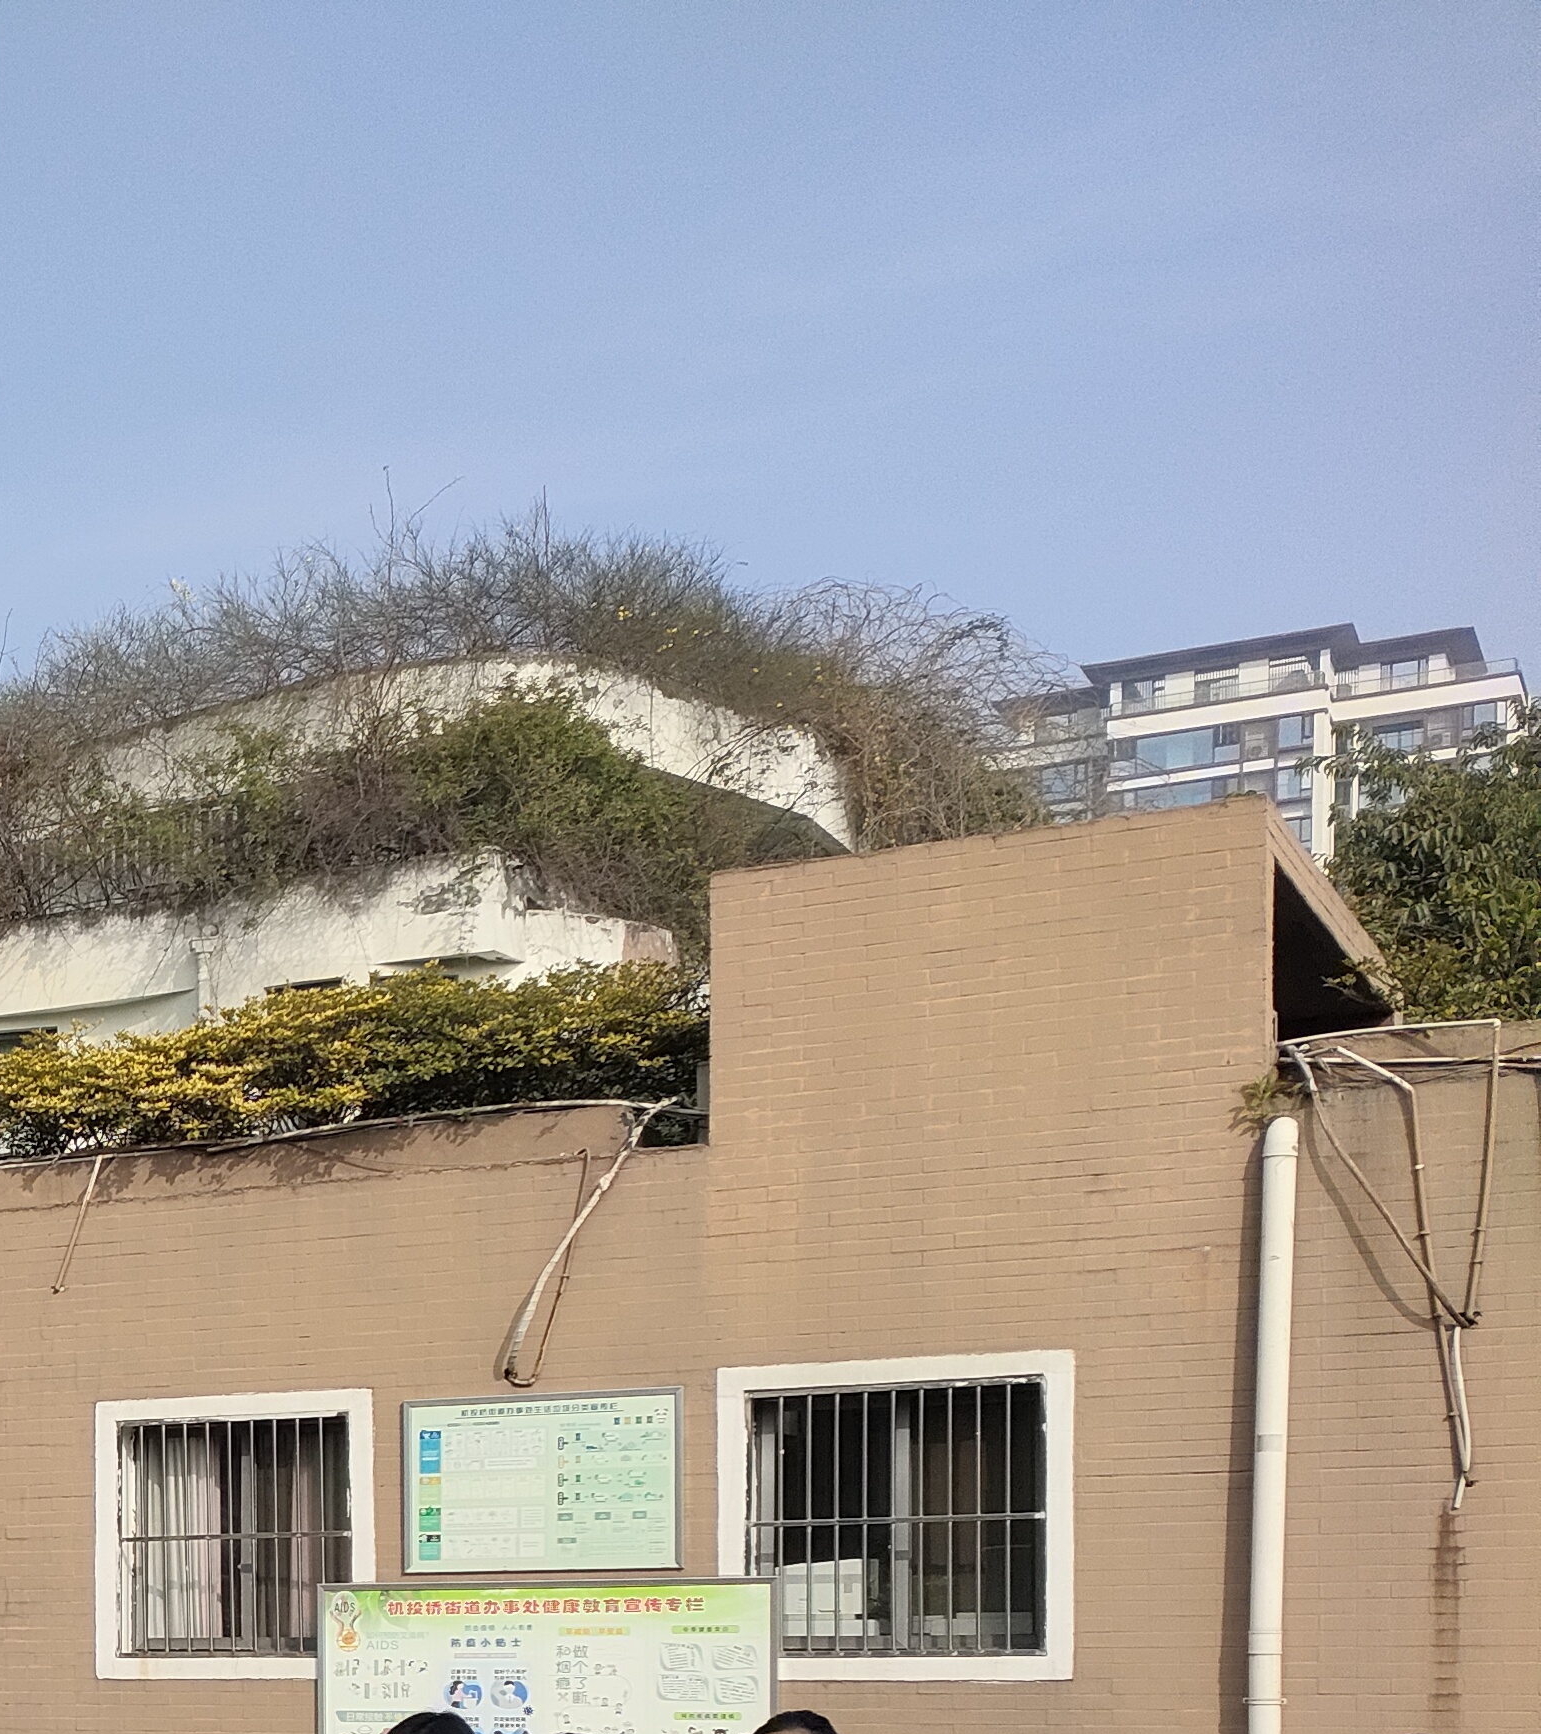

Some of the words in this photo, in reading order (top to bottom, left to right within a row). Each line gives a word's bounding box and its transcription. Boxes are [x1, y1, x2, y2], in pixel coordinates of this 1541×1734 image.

[334, 1602, 356, 1613] AIDS
[387, 1597, 705, 1616] 机投桥街道办事处健康教育宣传专栏
[366, 1640, 399, 1650] AIDS
